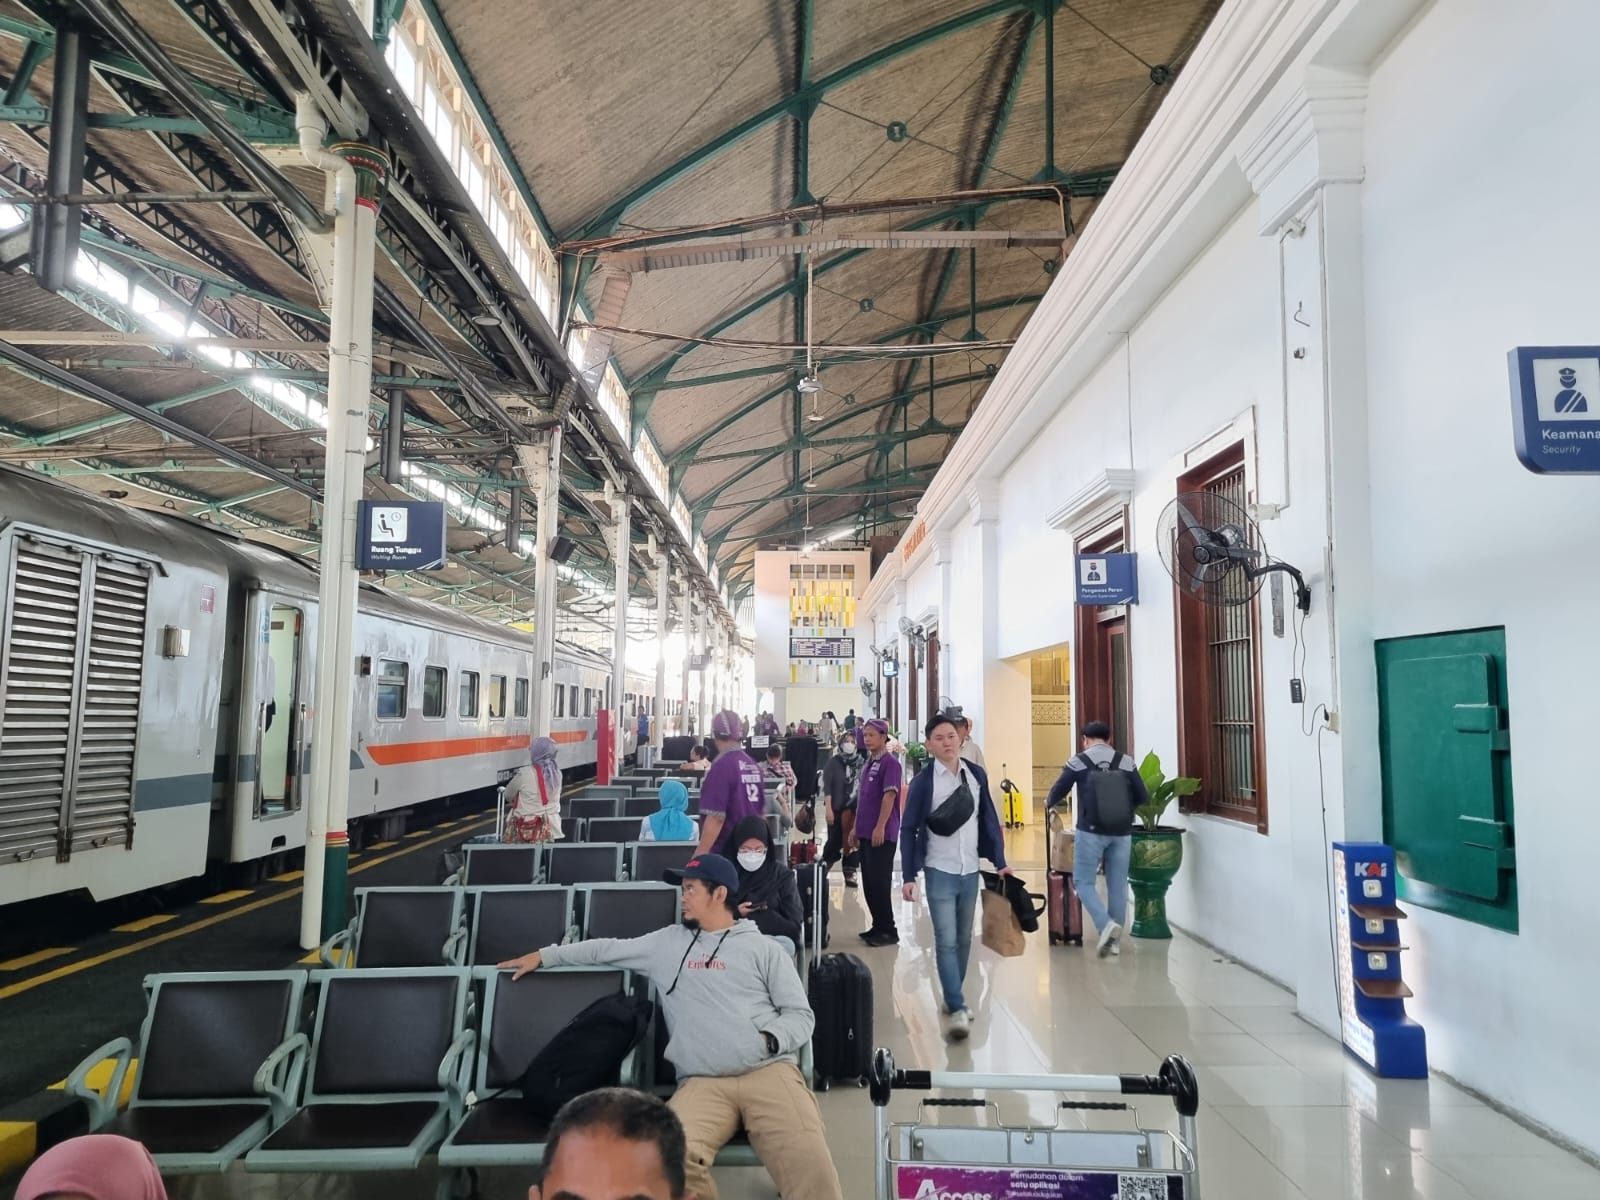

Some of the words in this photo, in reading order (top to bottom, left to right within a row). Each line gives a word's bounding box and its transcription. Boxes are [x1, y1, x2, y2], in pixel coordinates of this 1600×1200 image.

[1542, 445, 1581, 455] Security
[371, 545, 394, 554] Ruang
[395, 545, 422, 555] Tunggu
[1010, 1181, 1028, 1189] satu
[1029, 1181, 1060, 1190] aplikasi
